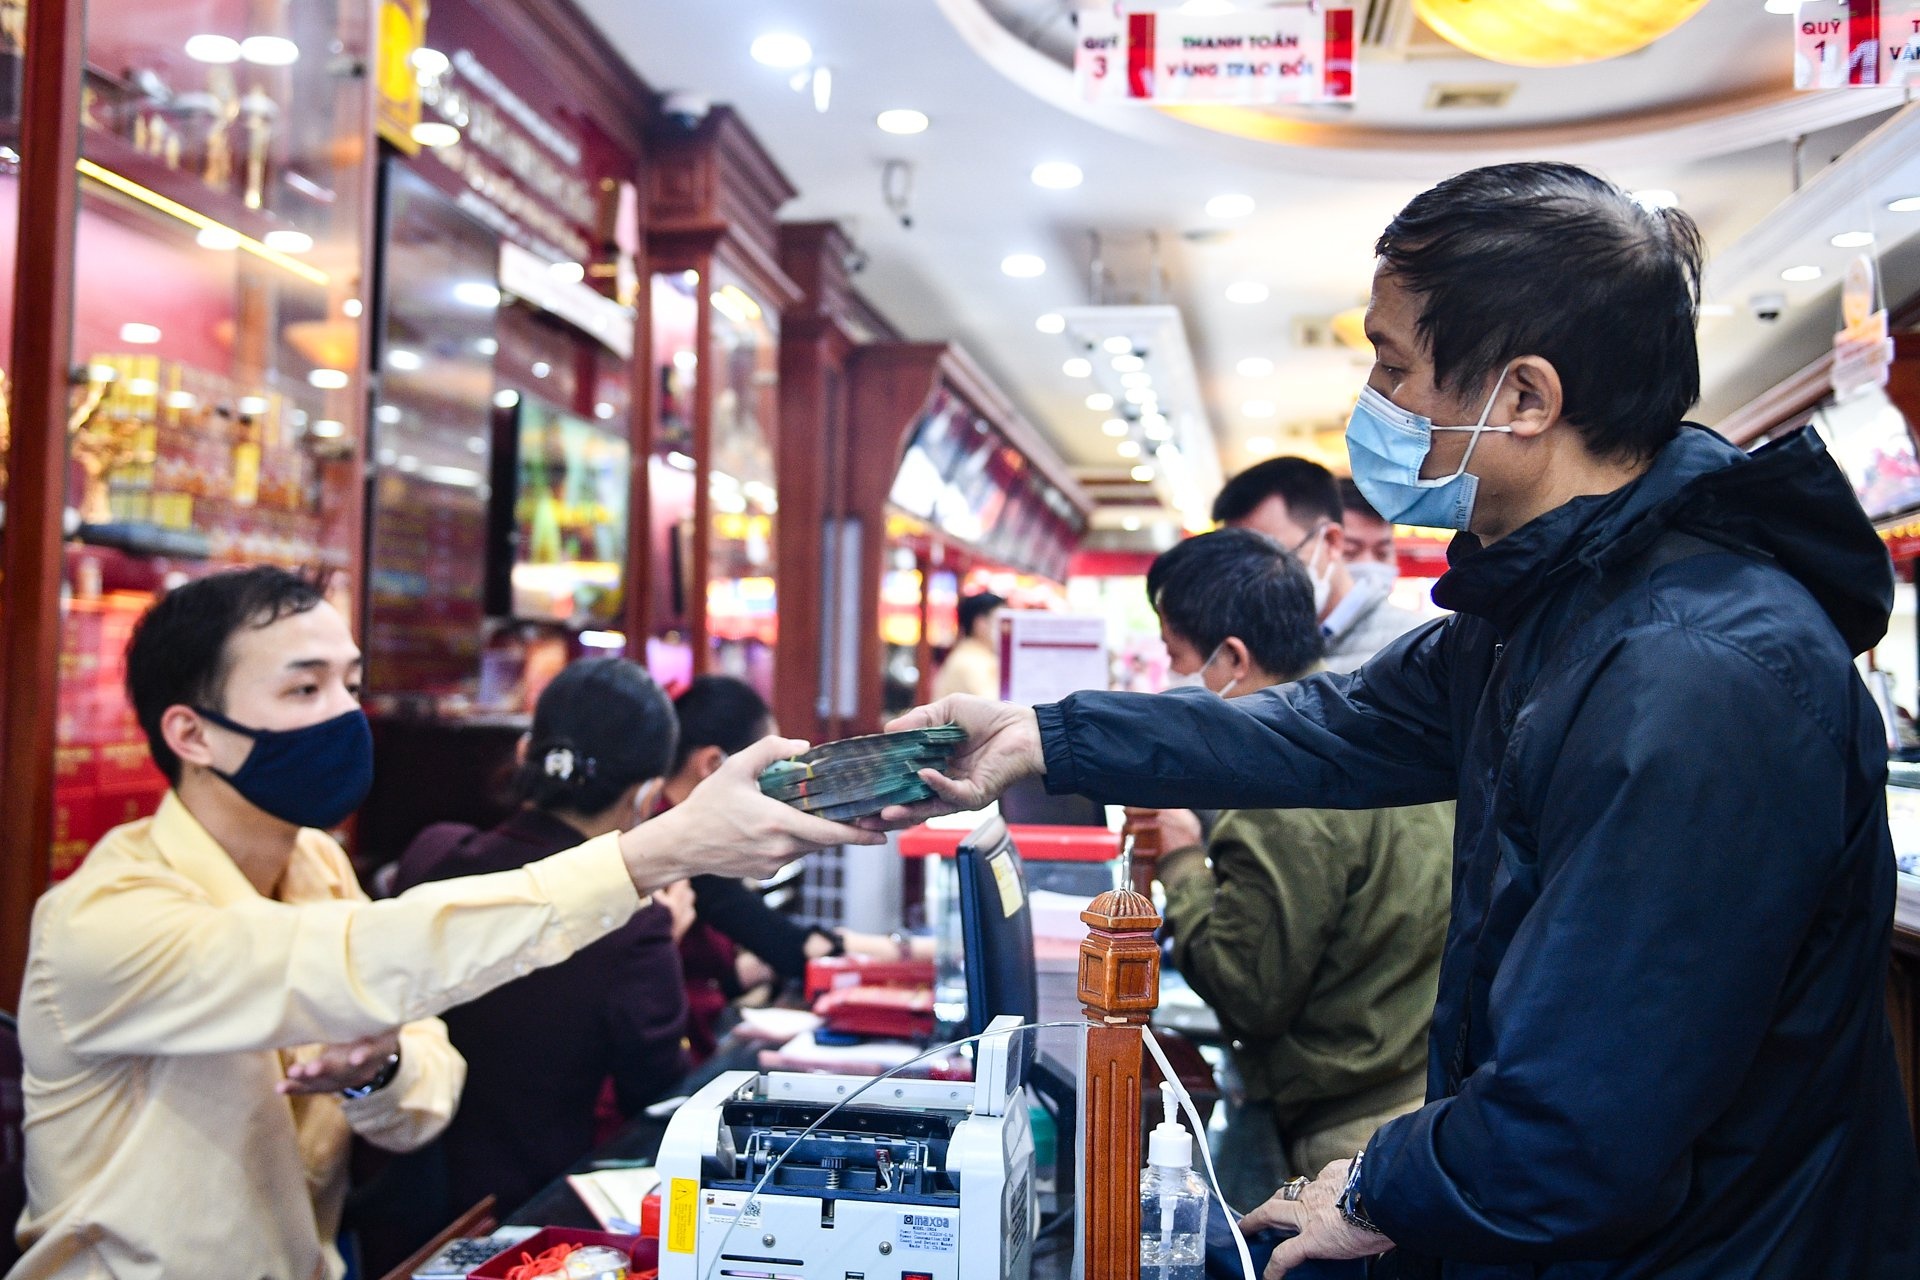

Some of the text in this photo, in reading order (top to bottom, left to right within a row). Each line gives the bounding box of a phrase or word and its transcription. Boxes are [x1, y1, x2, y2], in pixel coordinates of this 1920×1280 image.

[1802, 18, 1841, 34] QUỸ
[1182, 31, 1298, 49] THANH TOÁN
[1814, 40, 1826, 62] 1
[1094, 56, 1107, 78] 3
